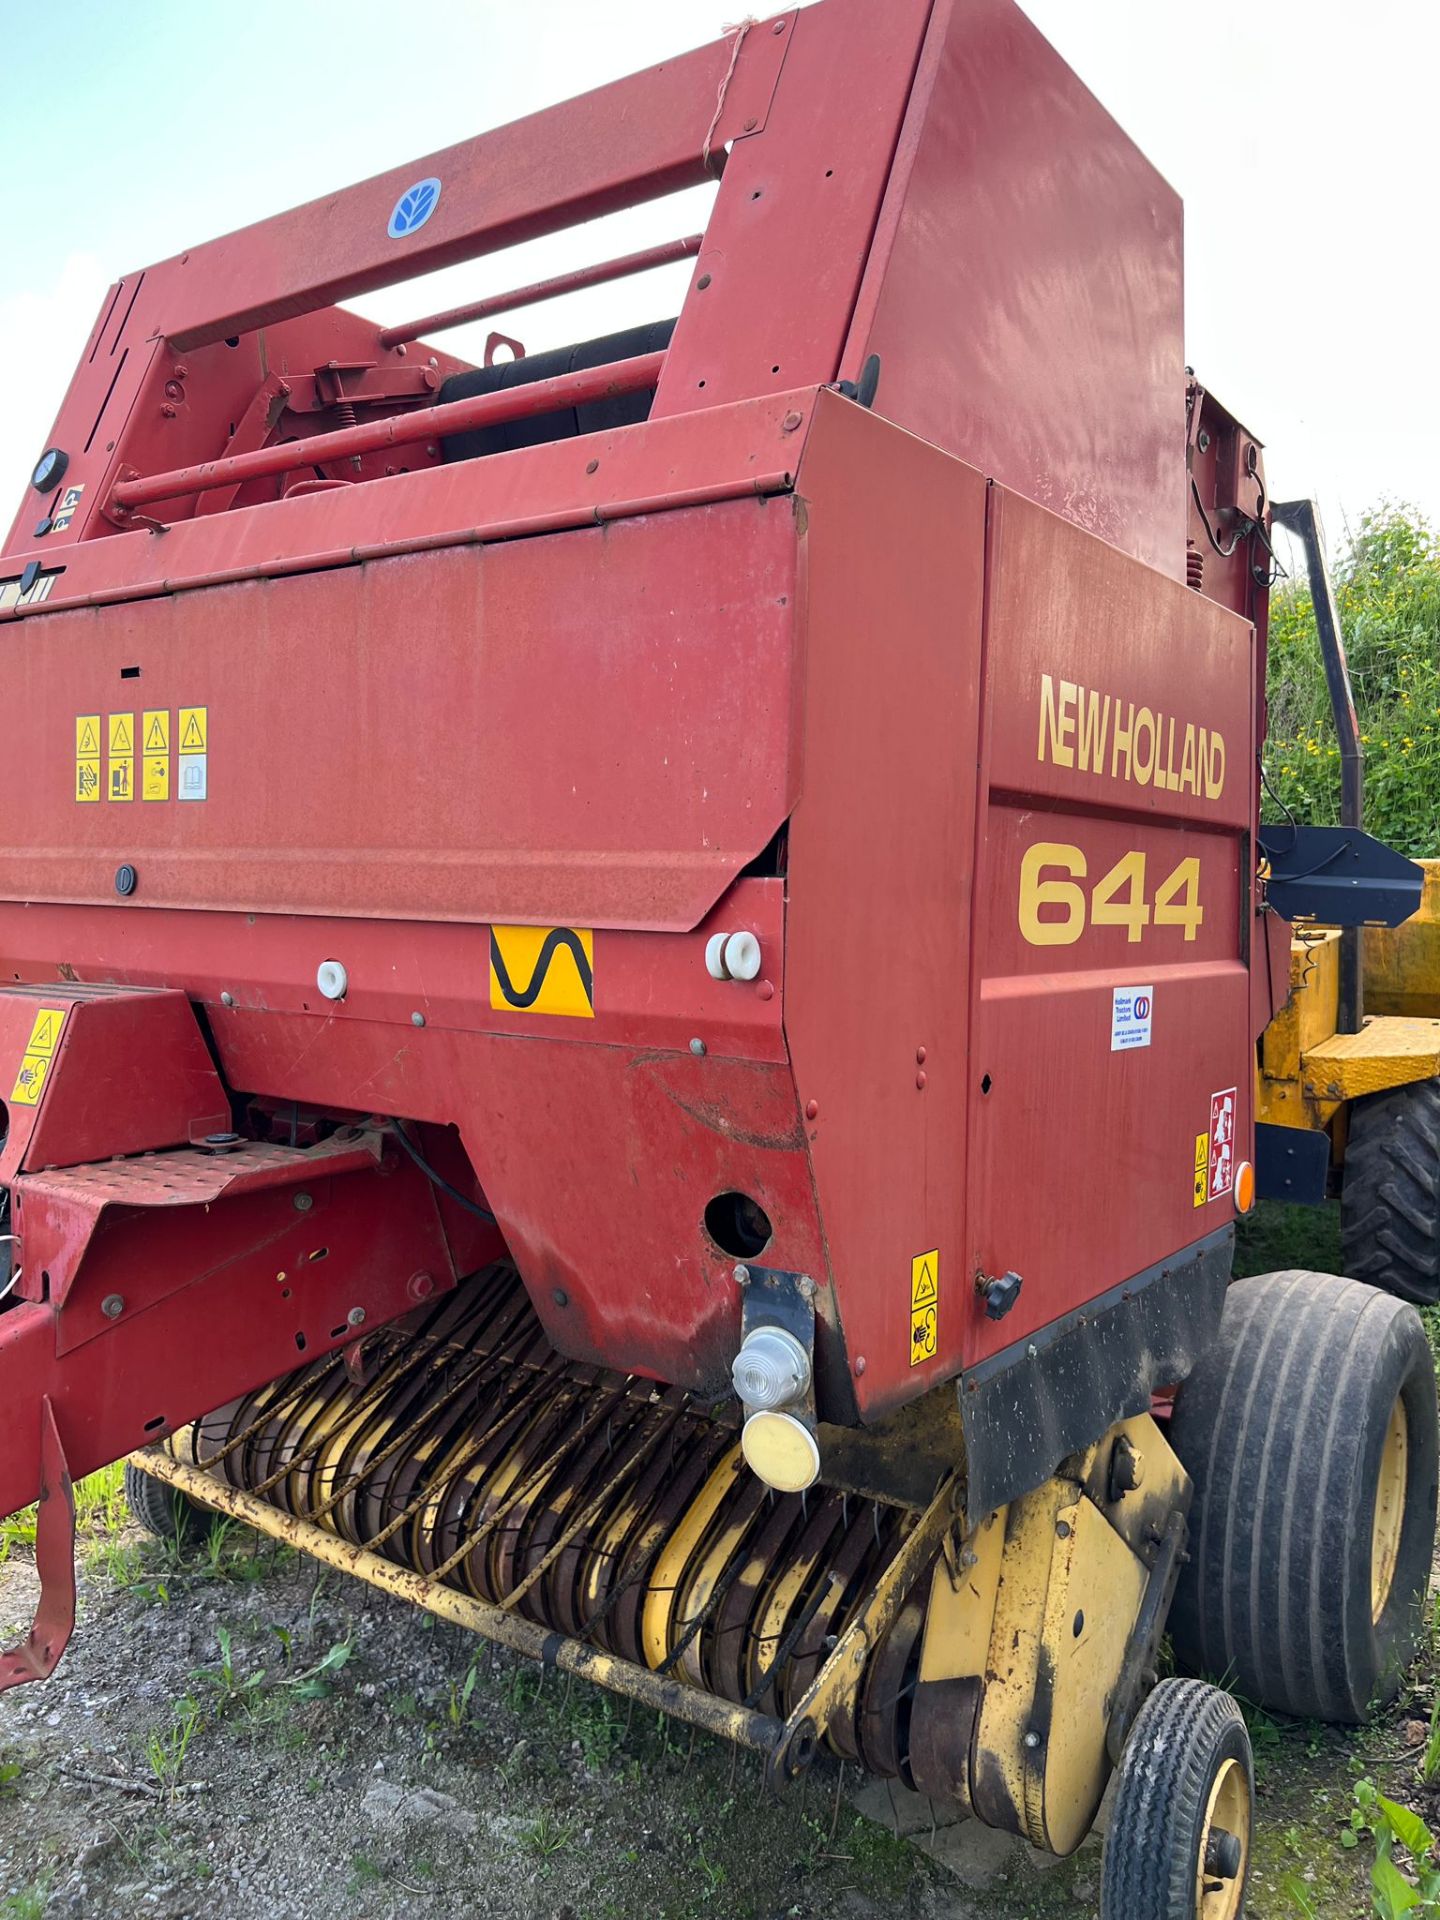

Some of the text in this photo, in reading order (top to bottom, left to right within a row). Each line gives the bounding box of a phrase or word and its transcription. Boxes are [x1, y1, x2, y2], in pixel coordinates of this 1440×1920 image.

[1037, 673, 1226, 800] NEW HOLLAND
[1018, 842, 1203, 946] 644
